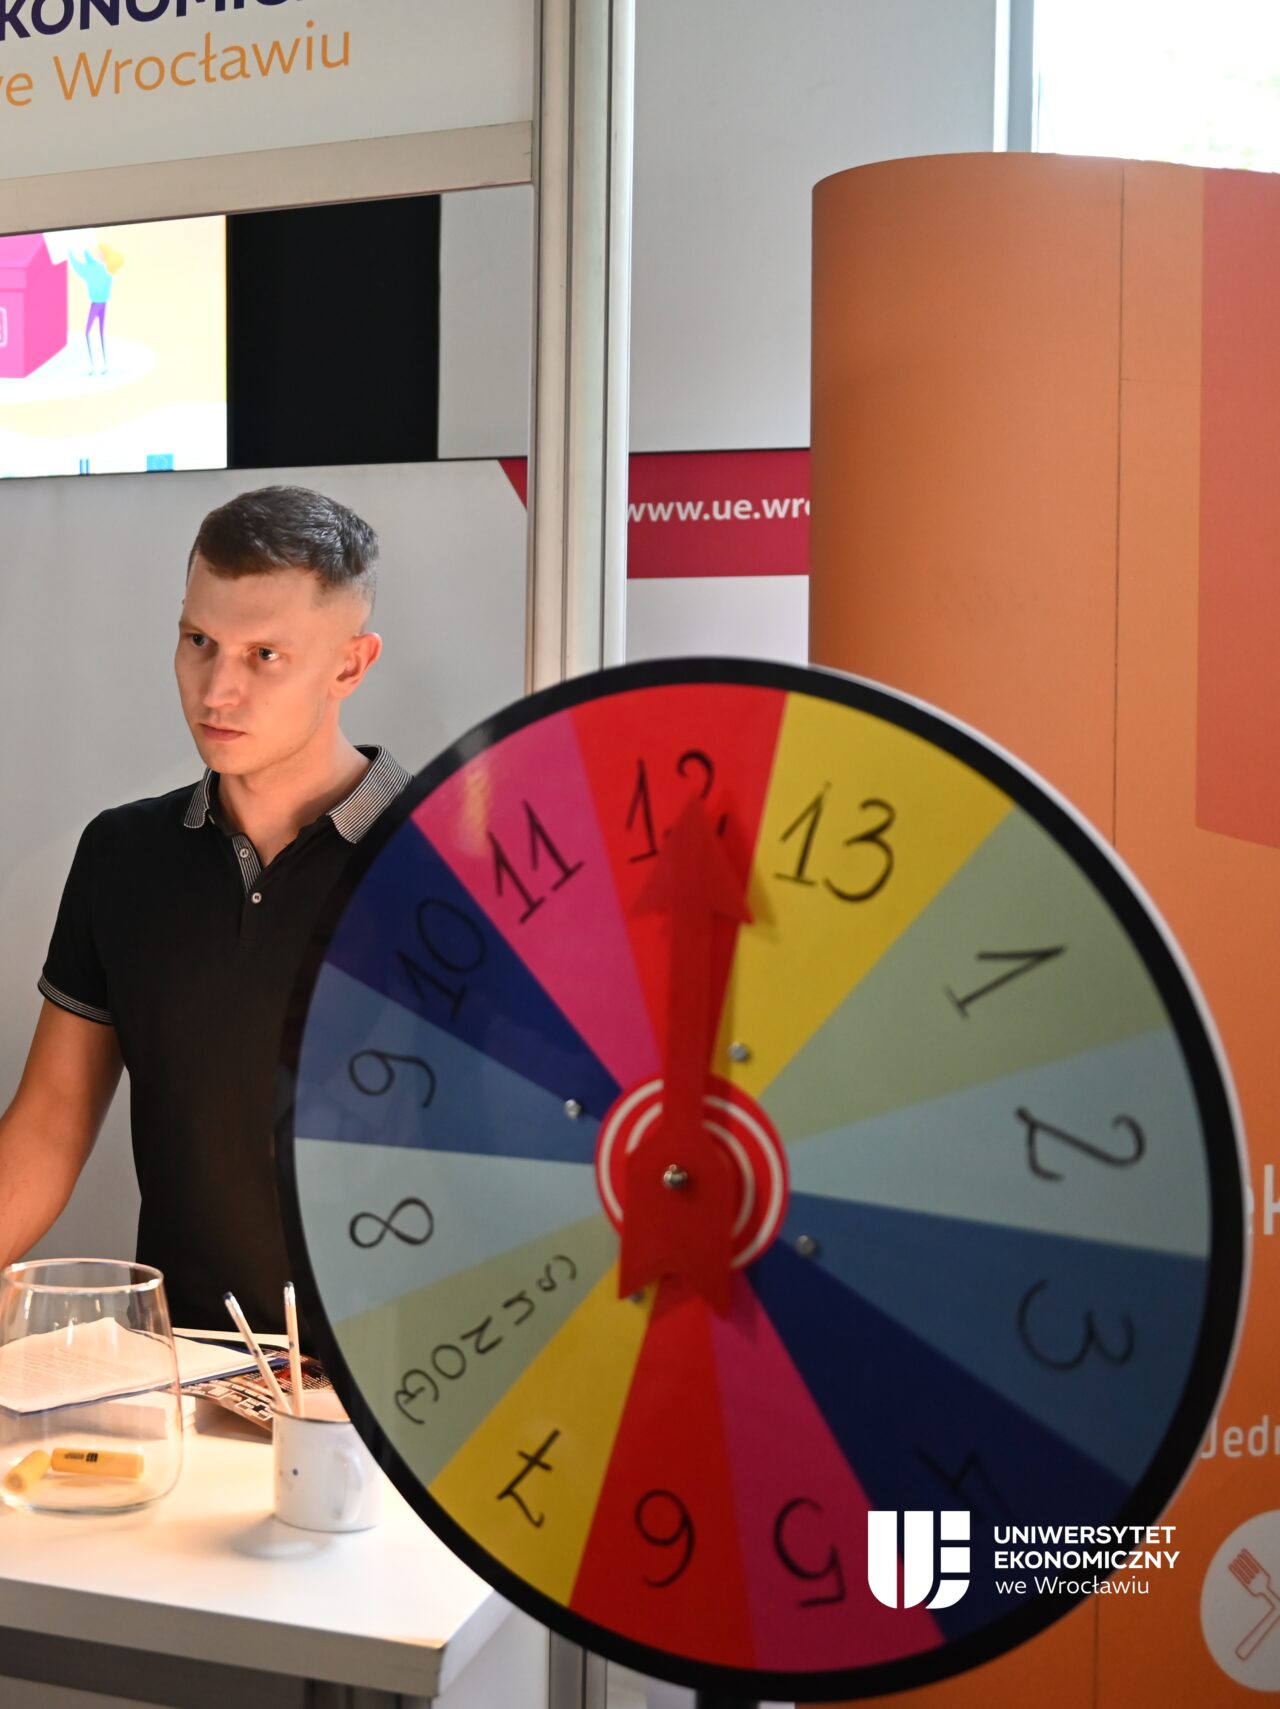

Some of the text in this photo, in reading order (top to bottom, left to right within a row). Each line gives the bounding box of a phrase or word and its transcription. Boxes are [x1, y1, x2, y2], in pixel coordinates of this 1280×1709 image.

[52, 19, 351, 101] Wrocławiu
[485, 798, 586, 926] 11
[773, 781, 897, 904] 13
[396, 896, 488, 1023] 10
[943, 943, 1069, 1021] 1
[348, 1048, 438, 1110] 9
[1014, 1105, 1147, 1183] 2
[348, 1196, 435, 1250] 8
[1017, 1277, 1137, 1372] 3
[496, 1428, 562, 1530] 7
[773, 1496, 847, 1609] 5
